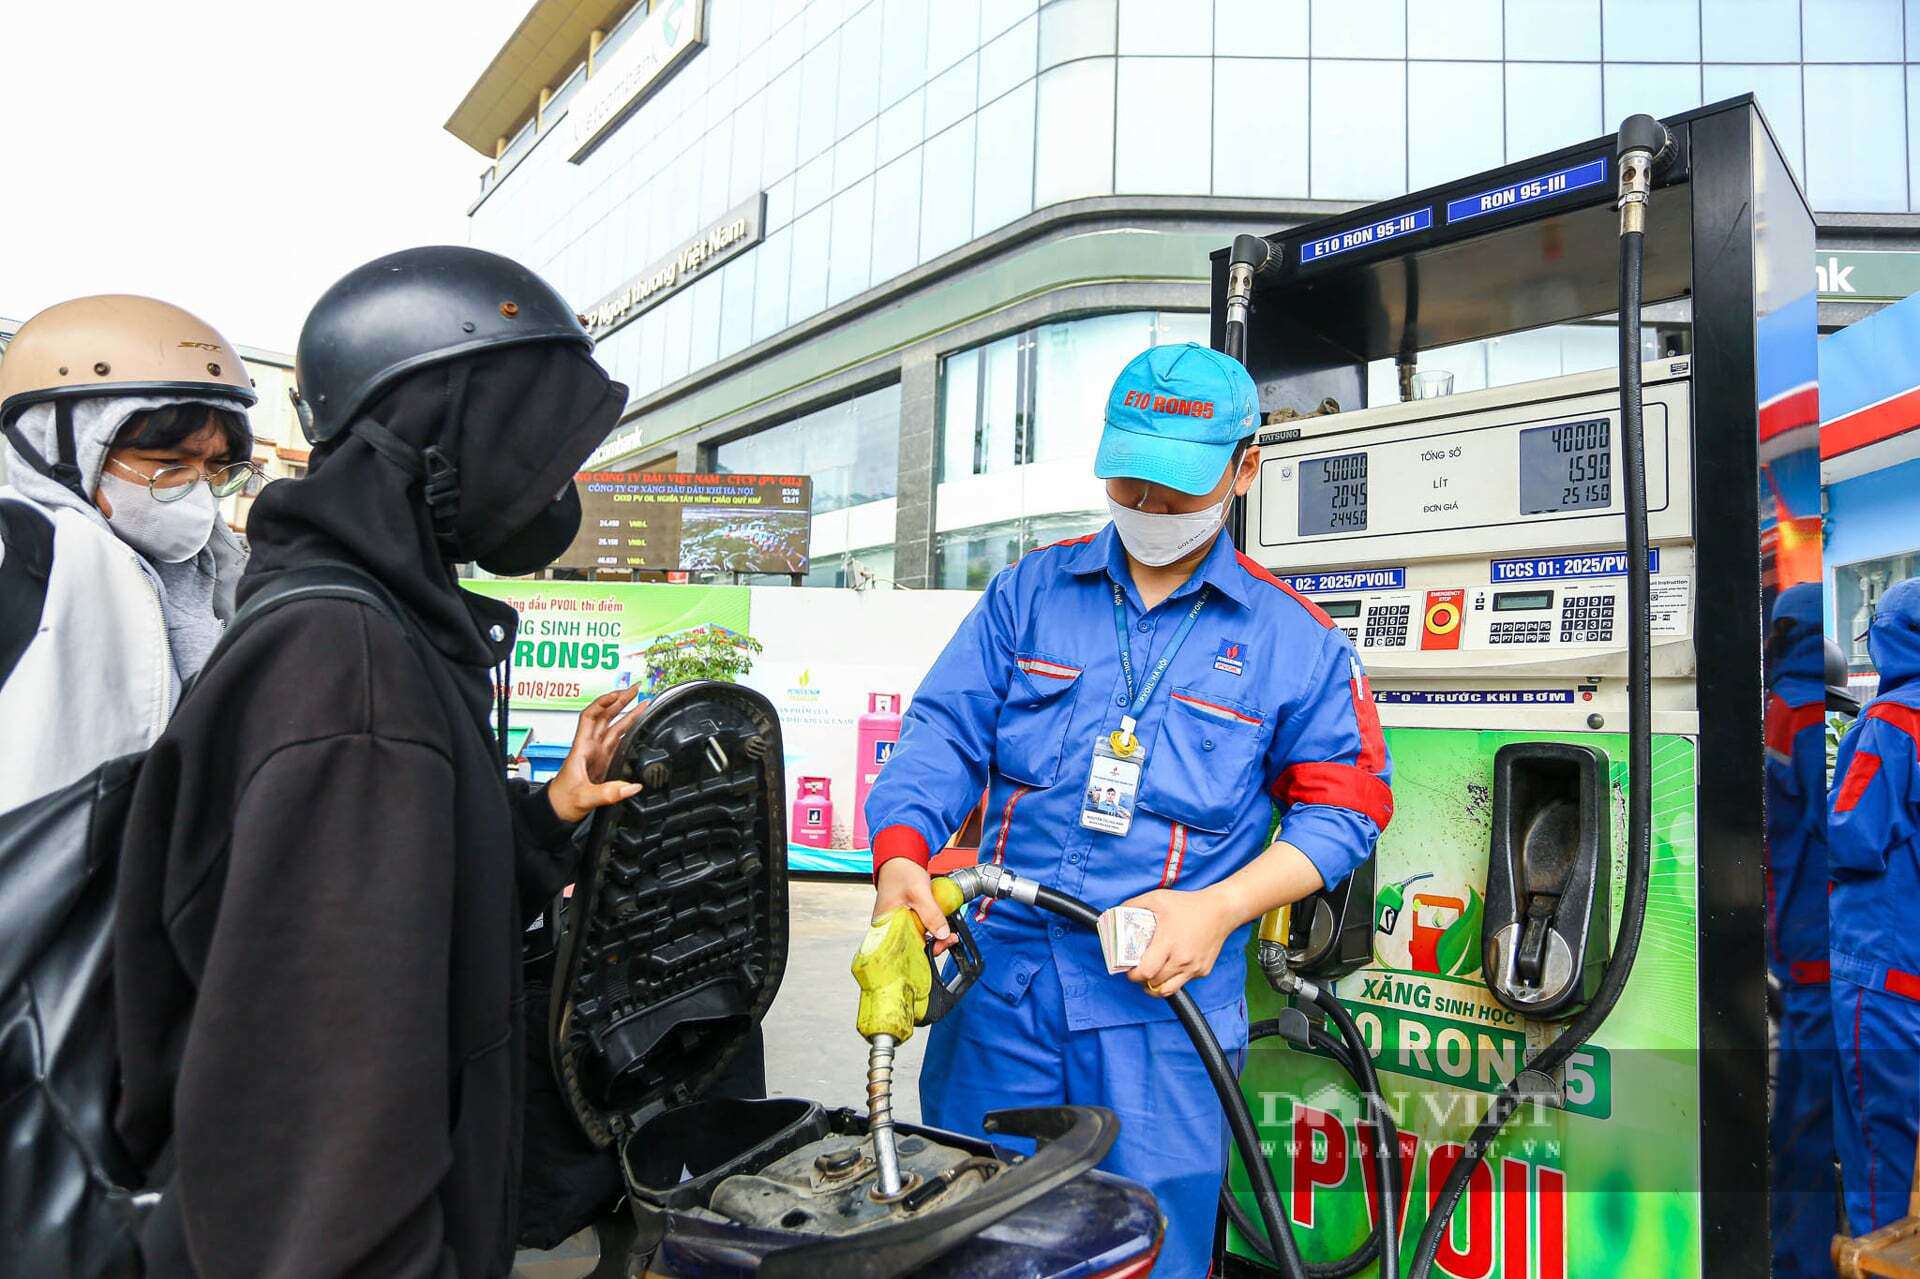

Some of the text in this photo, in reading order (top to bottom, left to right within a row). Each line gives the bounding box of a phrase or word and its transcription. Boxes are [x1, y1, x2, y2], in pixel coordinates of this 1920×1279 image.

[1481, 175, 1566, 211] RON 95-III
[677, 239, 709, 273] Việt
[708, 217, 746, 255] Nam
[1314, 216, 1416, 257] E10 RON 95-III
[1124, 390, 1216, 420] E10 RON95
[1260, 429, 1300, 442] TATSUNO
[1551, 421, 1610, 453] 40000
[1448, 446, 1463, 458] SỐ
[1323, 456, 1368, 483] 50000
[588, 483, 614, 494] CÔNG
[615, 484, 626, 494] TY
[627, 484, 640, 494] CP
[1433, 476, 1449, 489] LÍT
[1562, 483, 1610, 505] 25150
[1443, 502, 1459, 512] GIÁ
[1330, 510, 1367, 528] 24450
[1498, 555, 1628, 579] TCCS 01: 2025/PV
[1295, 579, 1316, 591] 02:
[1318, 571, 1397, 589] 2025/PVOIL
[1430, 590, 1461, 598] EMERGENCY
[507, 597, 526, 613] ăng
[550, 599, 577, 612] PVOIL
[517, 620, 535, 636] NG
[540, 621, 581, 636] SINH
[514, 640, 620, 670] RON95
[517, 680, 580, 699] 01/8/2025
[1425, 690, 1482, 703] TRƯỚC
[1486, 692, 1518, 702] KHI
[1523, 691, 1567, 703] BƠM
[1360, 977, 1516, 1027] XĂNG SINH HỌC
[1398, 1018, 1596, 1106] RON5
